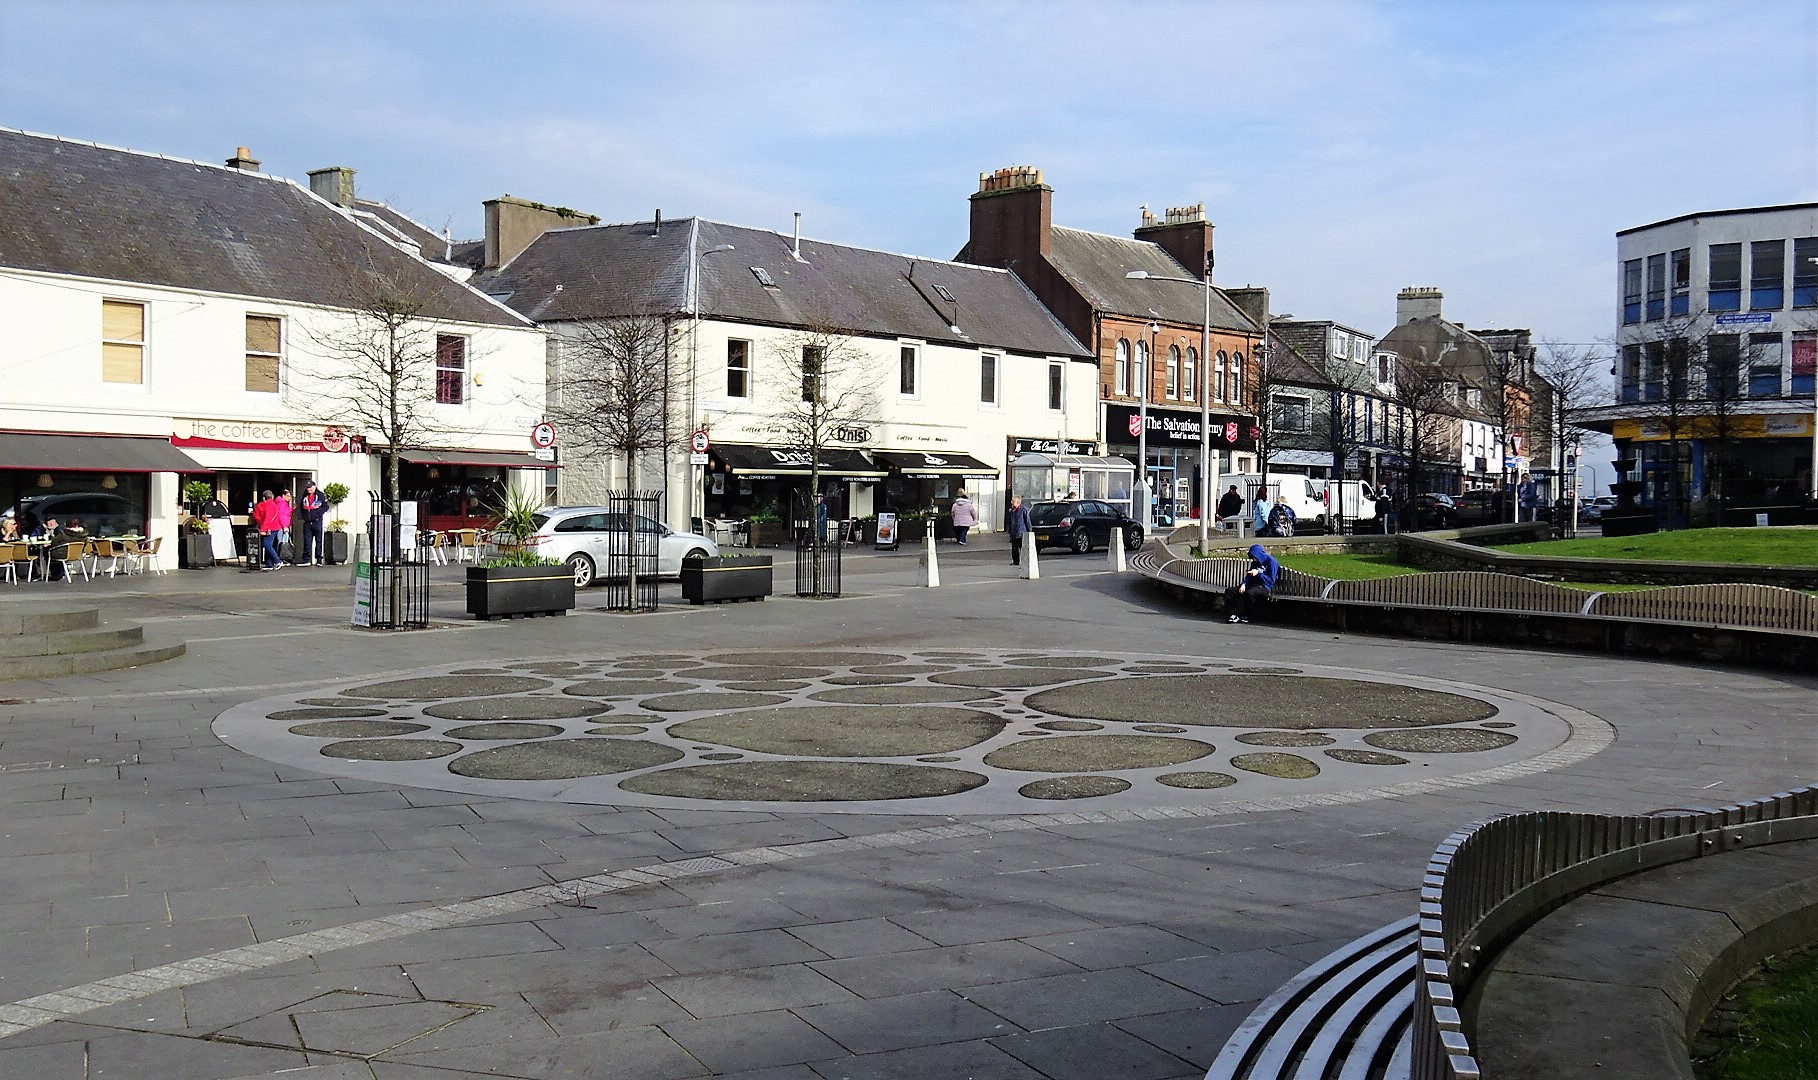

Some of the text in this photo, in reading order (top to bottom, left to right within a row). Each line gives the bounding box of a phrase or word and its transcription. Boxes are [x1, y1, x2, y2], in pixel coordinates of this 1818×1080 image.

[192, 420, 216, 437] the
[221, 421, 270, 439] coffee
[275, 423, 312, 441] bean
[1145, 416, 1223, 437] The Salvation rmy
[1169, 431, 1183, 439] belief
